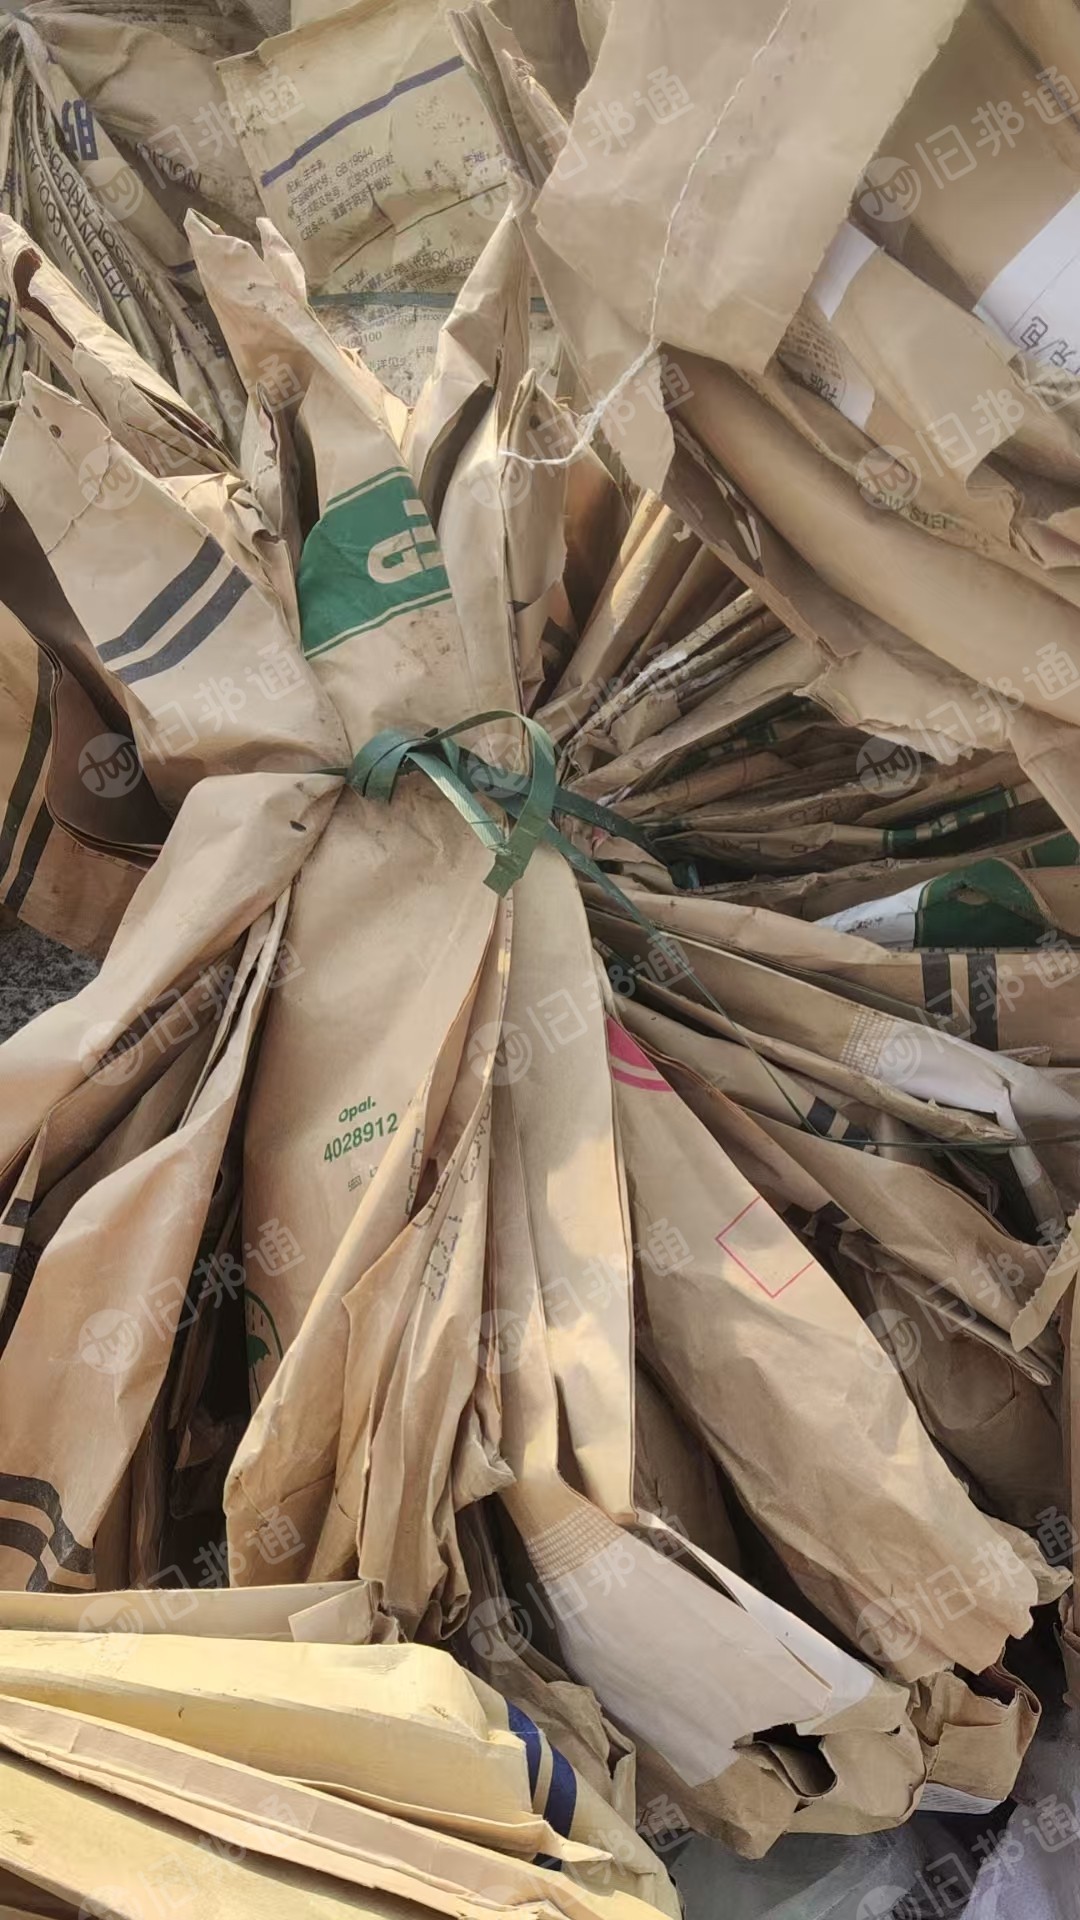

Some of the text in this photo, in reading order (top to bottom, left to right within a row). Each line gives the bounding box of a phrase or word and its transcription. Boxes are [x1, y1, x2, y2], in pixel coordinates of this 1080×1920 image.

[37, 171, 62, 237] COOL
[92, 249, 131, 304] KEEP
[323, 1112, 399, 1163] 4028912
